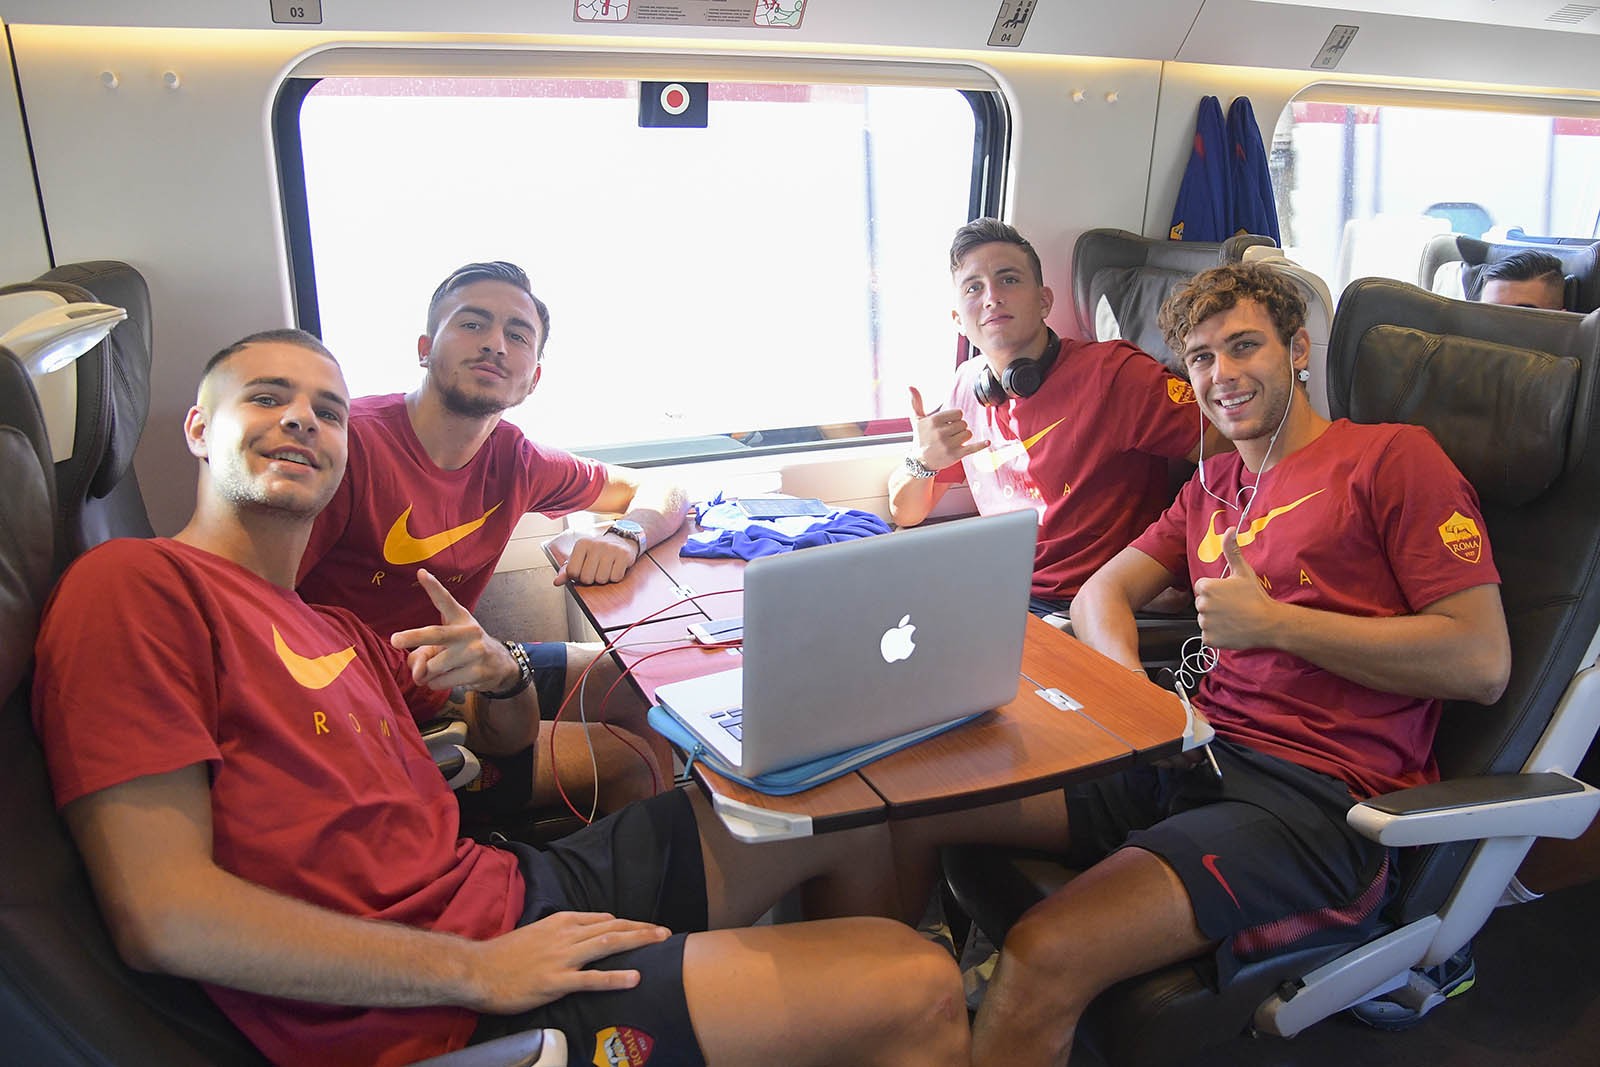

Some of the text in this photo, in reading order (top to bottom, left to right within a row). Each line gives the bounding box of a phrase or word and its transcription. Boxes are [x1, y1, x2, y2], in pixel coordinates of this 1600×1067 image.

[290, 7, 305, 18] 03
[1001, 33, 1012, 42] 04
[972, 481, 1071, 498] ROMA
[1452, 540, 1479, 553] ROMA
[623, 1028, 643, 1066] ROMA
